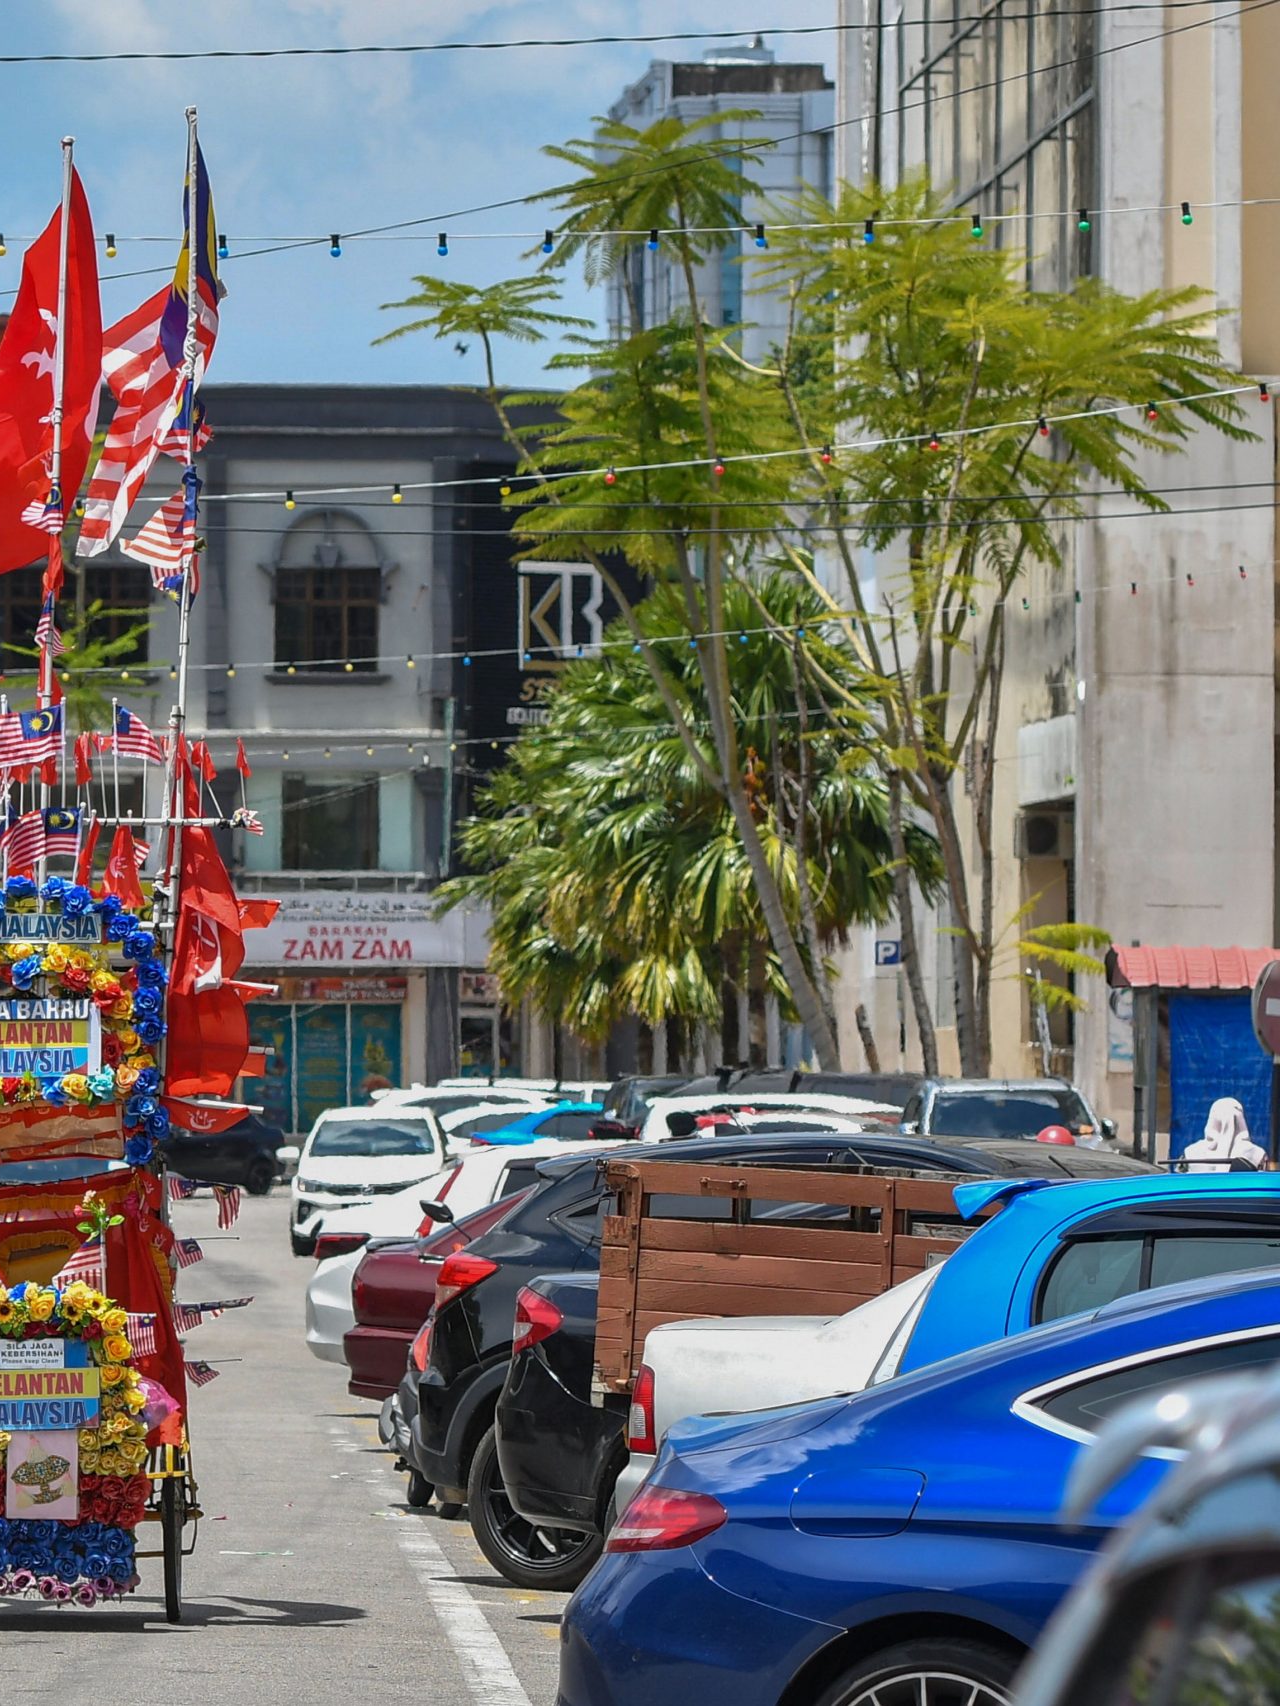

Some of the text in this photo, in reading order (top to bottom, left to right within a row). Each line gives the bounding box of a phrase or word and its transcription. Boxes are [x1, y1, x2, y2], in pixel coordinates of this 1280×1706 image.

[283, 939, 412, 960] ZAM ZAM
[878, 943, 897, 964] P
[16, 1000, 89, 1019] BAHRU
[0, 1350, 60, 1358] KEBERSIHAN
